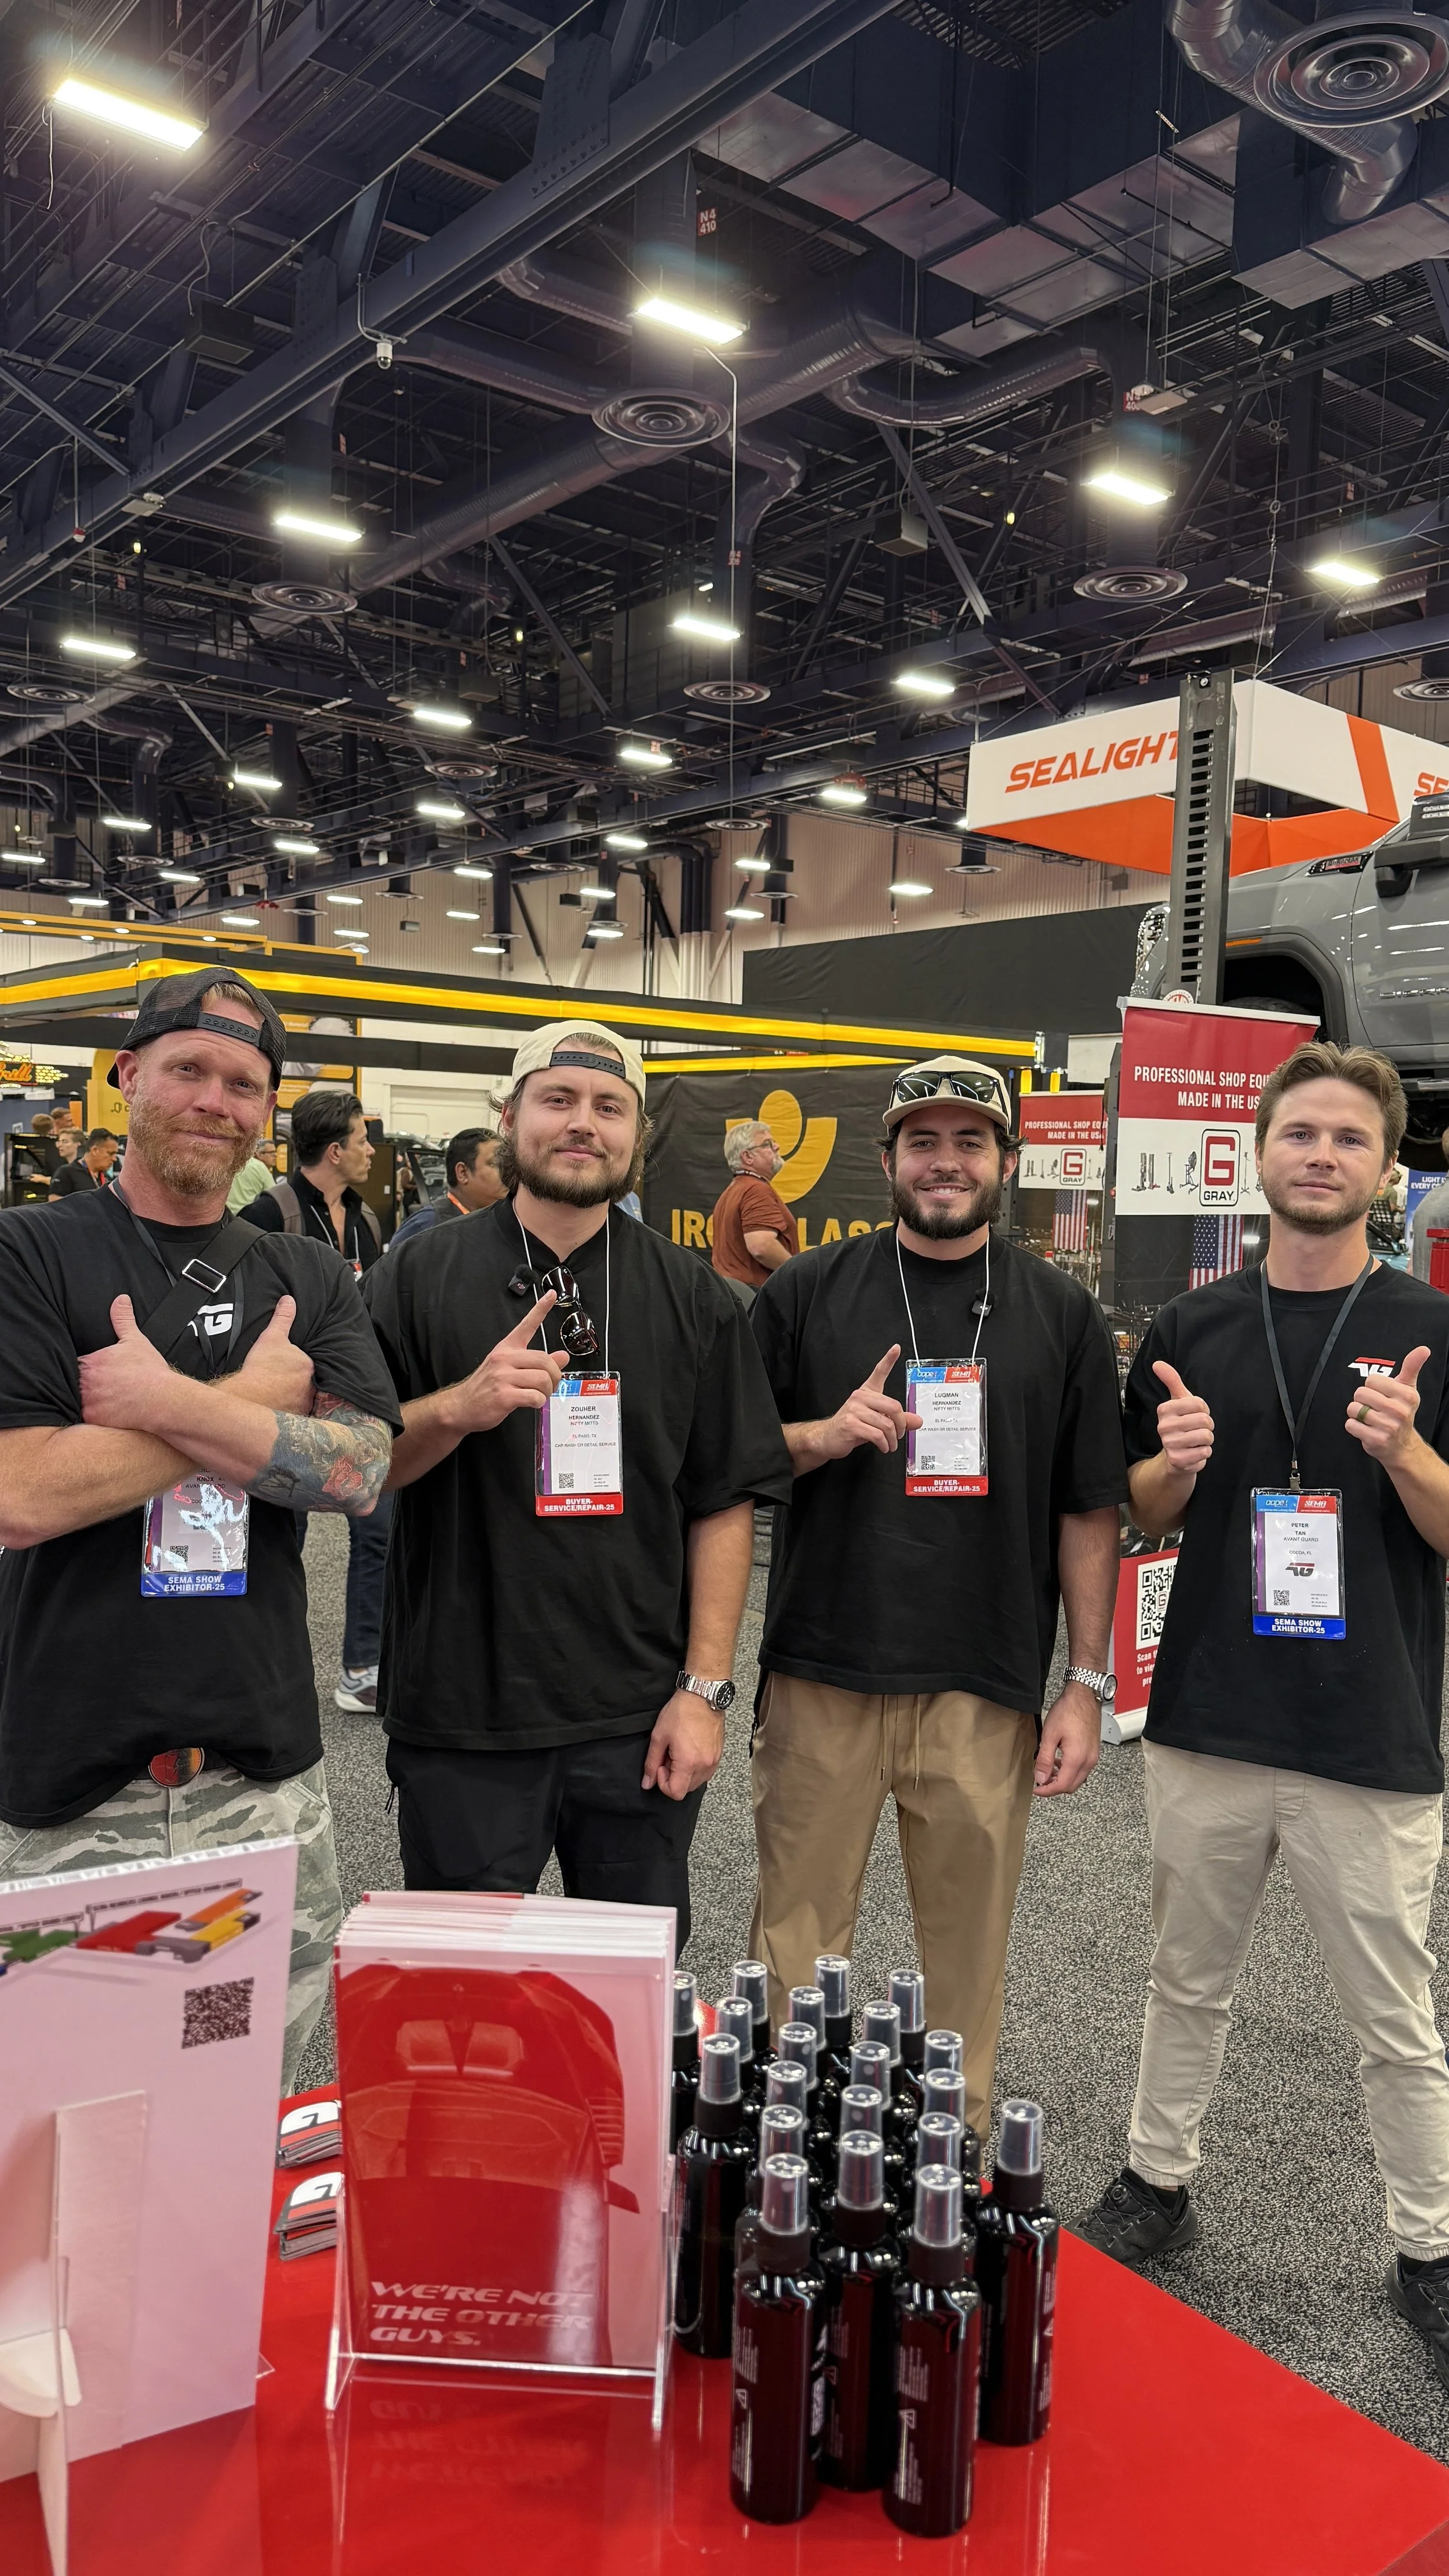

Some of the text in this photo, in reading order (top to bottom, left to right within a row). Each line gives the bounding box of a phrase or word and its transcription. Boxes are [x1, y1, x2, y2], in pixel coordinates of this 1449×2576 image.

[700, 208, 716, 224] N4
[700, 220, 716, 234] 410
[1134, 1066, 1216, 1086] PROFESSIONAL
[1219, 1072, 1246, 1087] SHOP
[1178, 1091, 1261, 1110] MADE IN THE US
[1025, 1121, 1072, 1129] PROFESSIONAL
[1073, 1121, 1090, 1129] SHOP
[1047, 1131, 1066, 1140] MADE
[1063, 1152, 1083, 1176] G
[1204, 1136, 1235, 1186] G
[1203, 1191, 1235, 1201] GRAY
[544, 1504, 615, 1512] SERVICE/REPAIR-25
[168, 1575, 223, 1585] SEMA SHOW
[1274, 1618, 1322, 1627] SEMA SHOW
[1137, 1653, 1152, 1662] Scan
[1137, 1667, 1143, 1675] to
[371, 2281, 594, 2307] WE'RE NOT
[372, 2304, 592, 2330] THE OTHER
[370, 2326, 482, 2346] GUYS.
